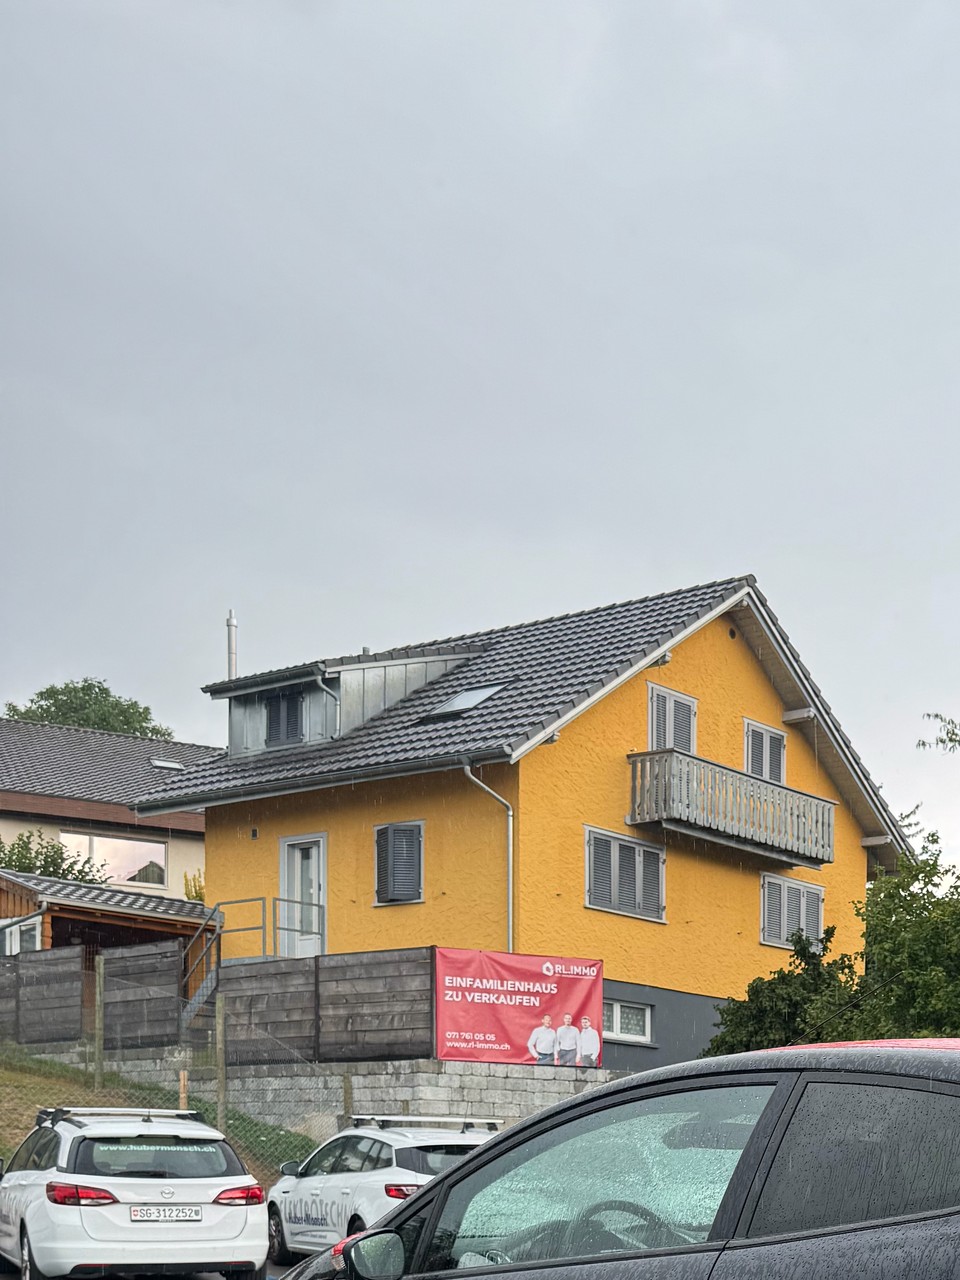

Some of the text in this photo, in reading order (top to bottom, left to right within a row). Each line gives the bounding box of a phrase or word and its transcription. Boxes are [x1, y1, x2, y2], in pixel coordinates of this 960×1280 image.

[555, 964, 597, 976] RL.IMMO
[444, 976, 558, 994] EINFAMILIENHAUS
[444, 991, 540, 1007] ZU VERKAUFEN
[446, 1040, 511, 1050] www.rl-immo.ch
[100, 1144, 216, 1153] www.hubermonsch.ch
